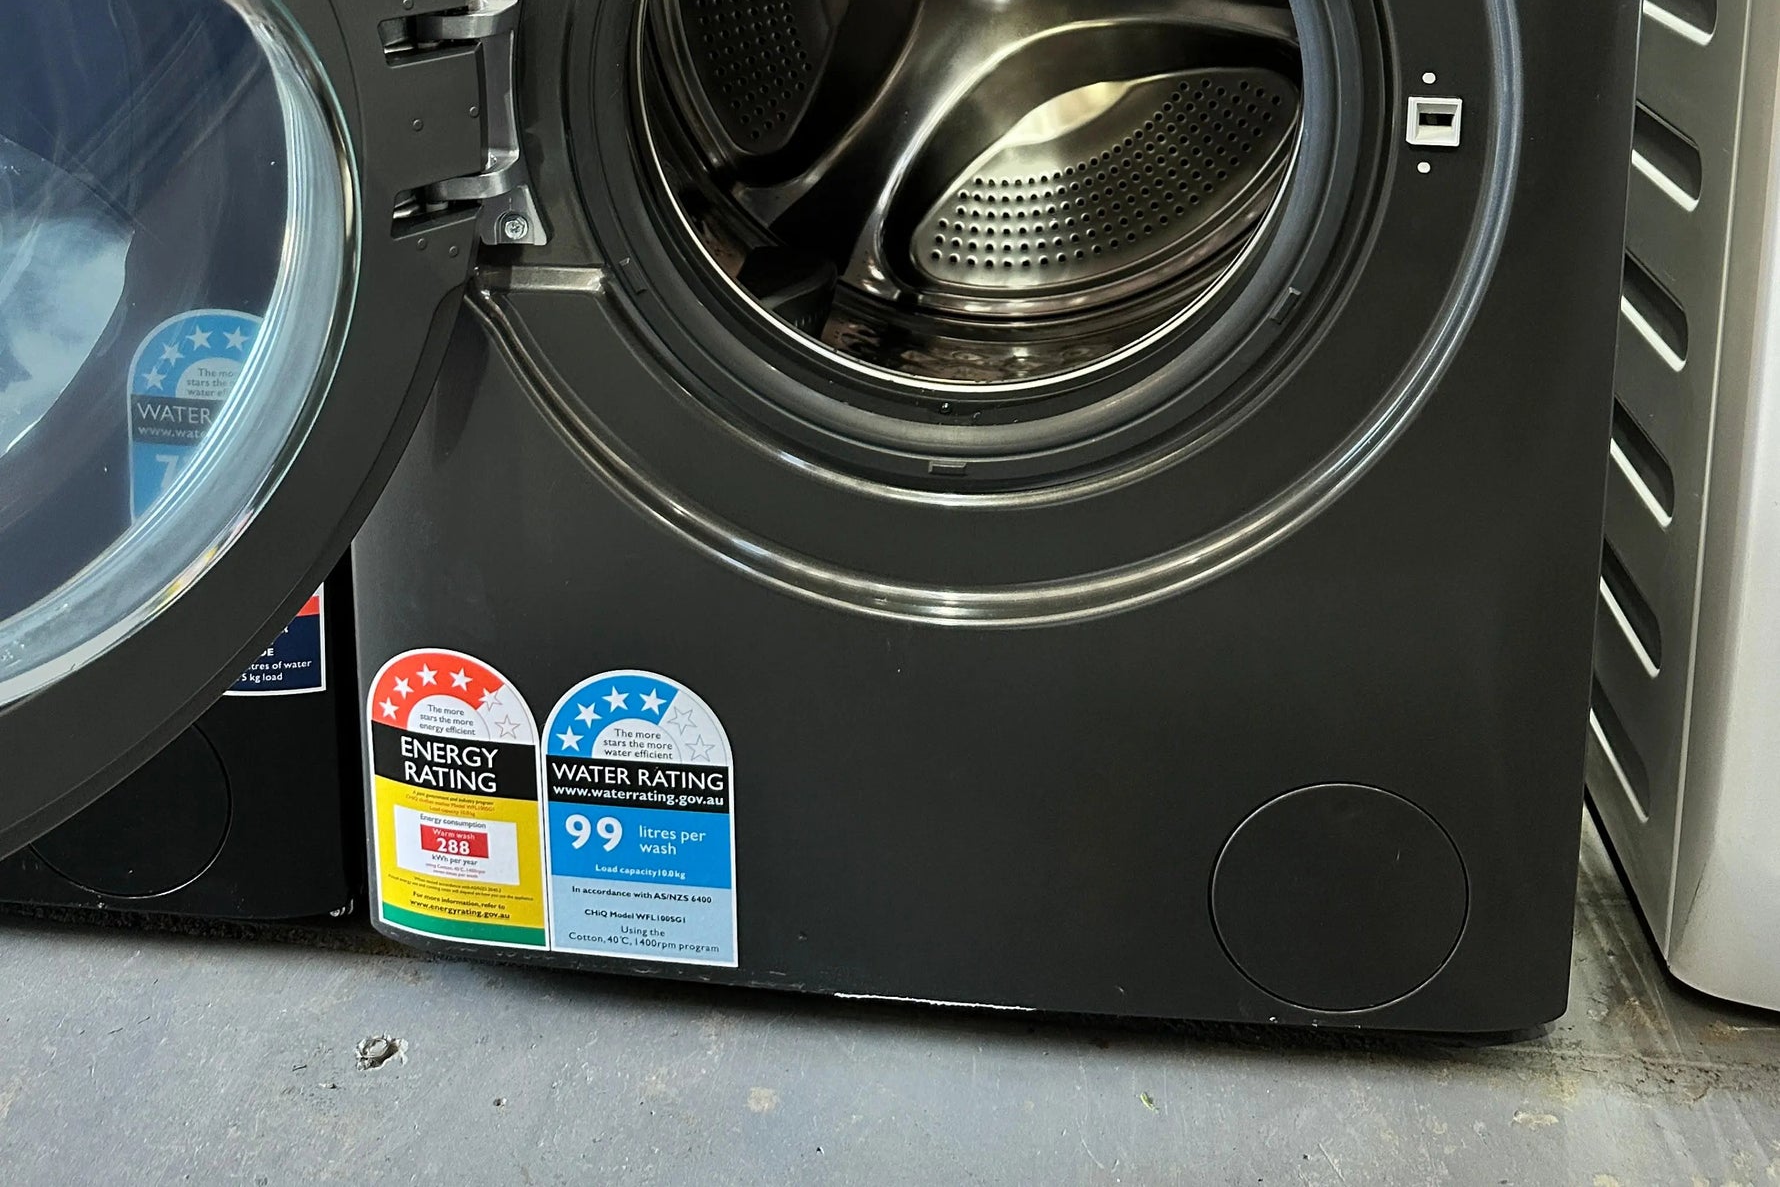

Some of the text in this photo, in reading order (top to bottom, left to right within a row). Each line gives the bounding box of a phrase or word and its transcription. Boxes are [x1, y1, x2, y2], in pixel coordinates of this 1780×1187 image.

[198, 368, 216, 377] The
[187, 379, 210, 387] stars
[137, 402, 213, 426] WATER
[272, 661, 282, 670] of
[283, 660, 312, 669] water
[249, 674, 261, 684] kg
[262, 673, 283, 682] load
[428, 704, 464, 716] The more
[420, 714, 474, 726] stars the more
[420, 723, 476, 735] energy efficient
[614, 728, 661, 740] The more
[603, 739, 673, 750] stars the more
[401, 735, 499, 768] ENERGY
[604, 748, 673, 760] water efficient
[404, 760, 497, 793] RATING
[551, 762, 725, 791] WATER RATING
[552, 784, 724, 807] www.waterrating.gov.au
[420, 813, 487, 829] Energy consumption
[433, 828, 475, 840] Warm wash
[565, 813, 707, 853] 99 litres per
[436, 837, 470, 855] 288
[640, 842, 677, 855] wash
[432, 854, 448, 862] kWh
[463, 858, 478, 866] year
[595, 864, 618, 873] Load
[572, 885, 712, 904] In accordance with AS/NZS 6400
[424, 894, 441, 902] more
[481, 901, 497, 909] refer
[410, 899, 510, 920] www.energyrating.gov.au
[585, 909, 608, 918] CHiQ
[610, 911, 635, 919] Model
[620, 925, 665, 937] Using the
[635, 937, 676, 950] 1400rpm
[678, 943, 720, 953] program
